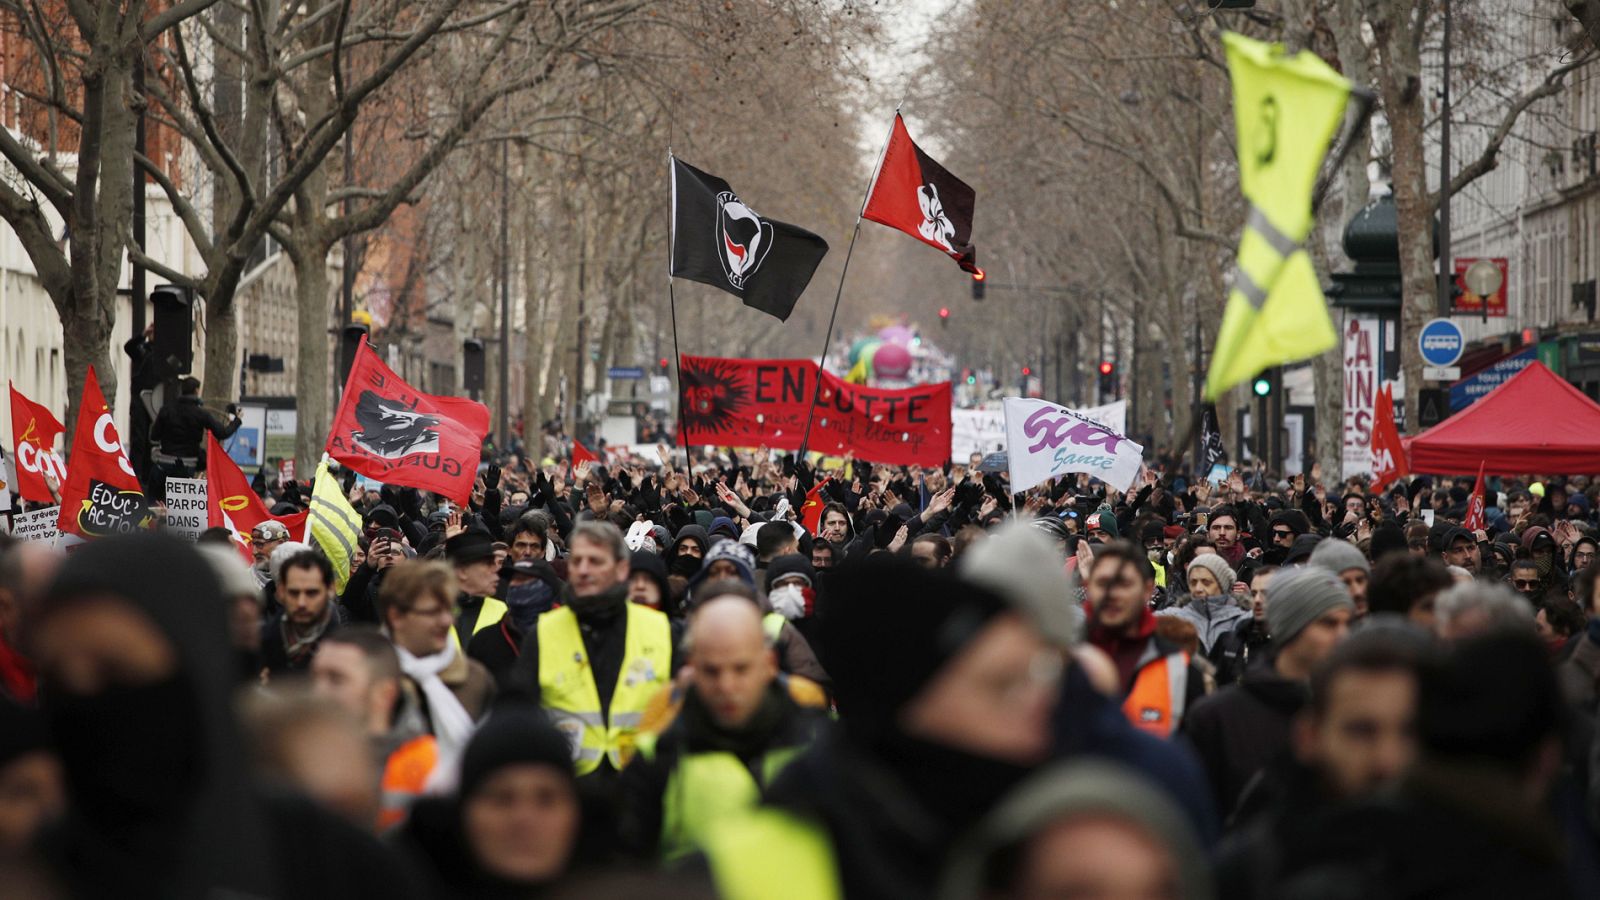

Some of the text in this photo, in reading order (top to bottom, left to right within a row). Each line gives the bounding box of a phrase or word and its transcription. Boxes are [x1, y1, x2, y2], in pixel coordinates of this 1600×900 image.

[756, 366, 931, 423] EN LUTTE
[166, 497, 190, 511] PAR
[168, 515, 200, 528] DANS
